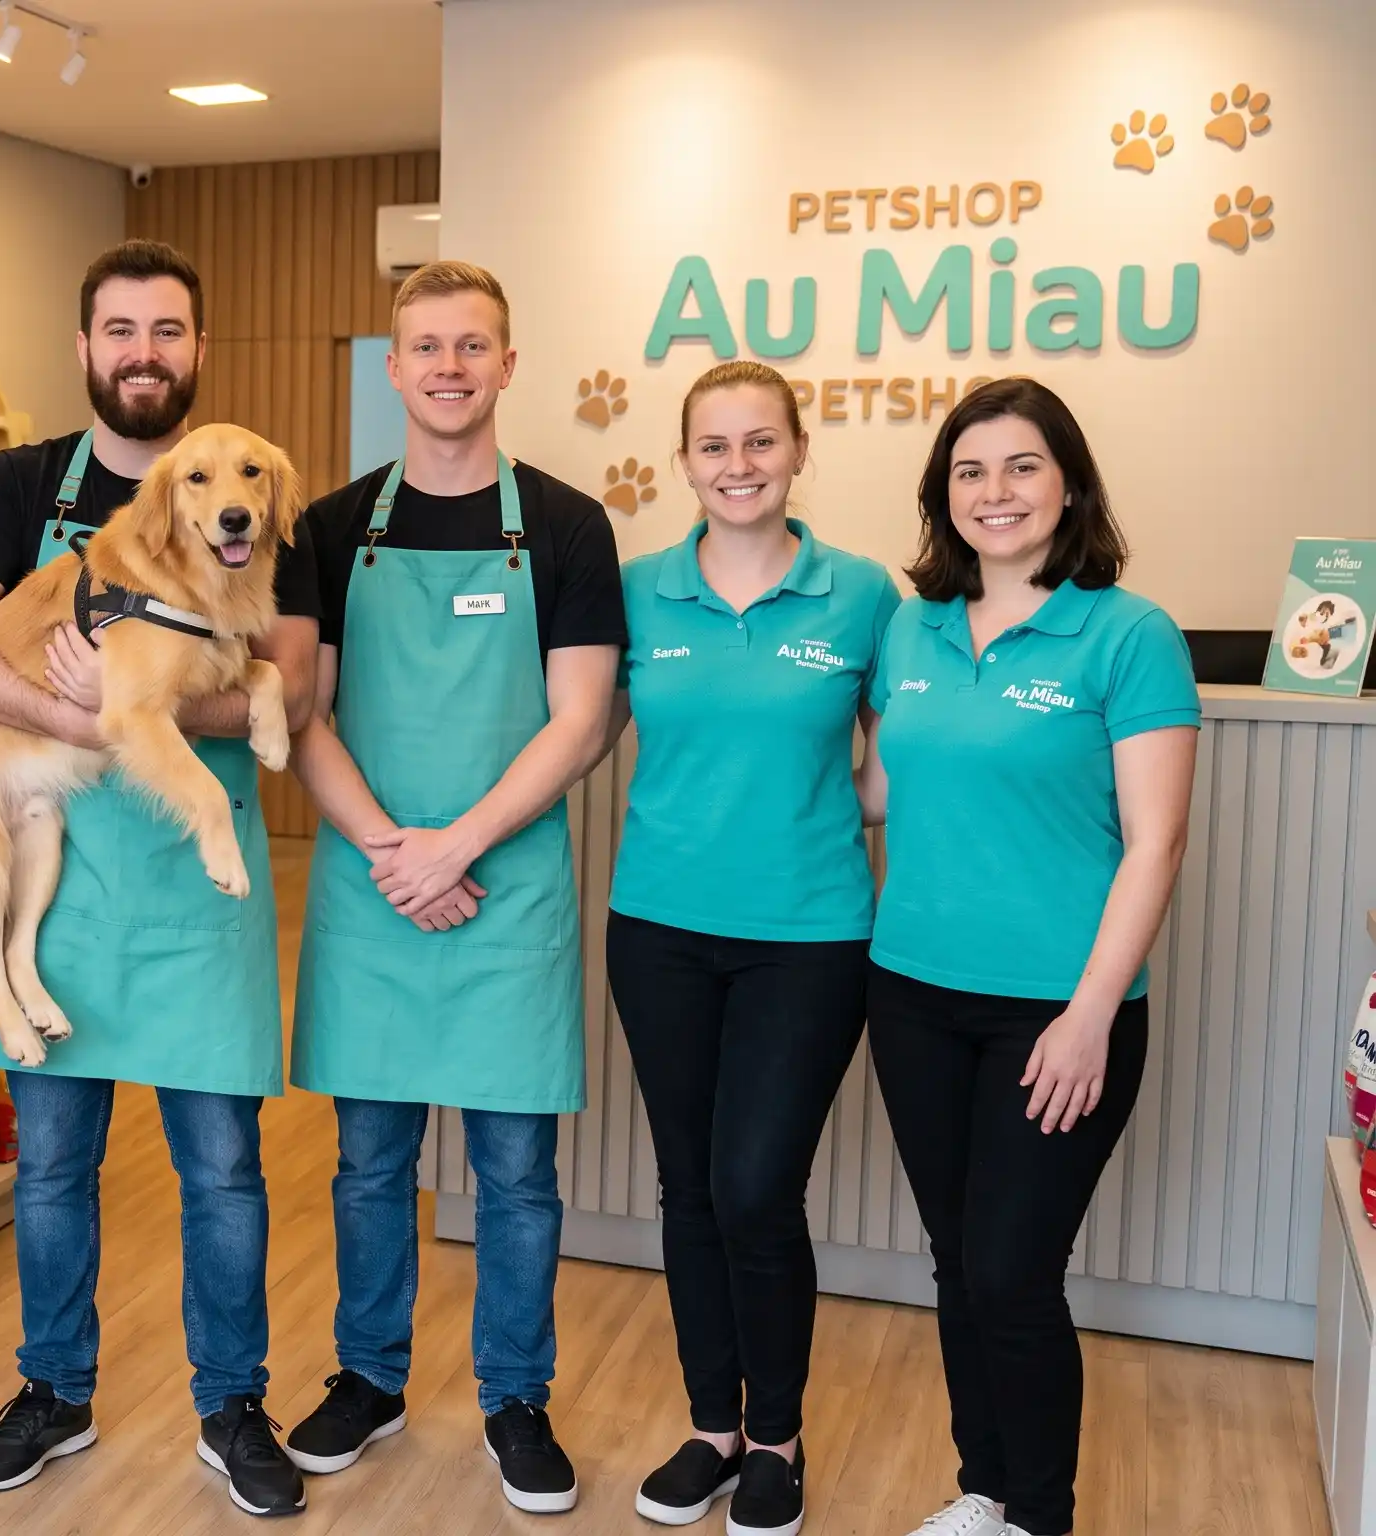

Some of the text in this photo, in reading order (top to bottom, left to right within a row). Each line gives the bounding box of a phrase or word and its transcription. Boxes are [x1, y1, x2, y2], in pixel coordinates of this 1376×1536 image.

[788, 180, 1043, 234] PETSHOP
[644, 236, 1201, 360] Au Miau
[787, 375, 1032, 421] PETSH
[1315, 555, 1363, 570] Au Miau
[652, 646, 691, 659] Sarah
[776, 643, 802, 659] Au
[804, 645, 844, 667] Miau
[899, 679, 932, 693] Emily
[1001, 684, 1075, 709] Au Miau
